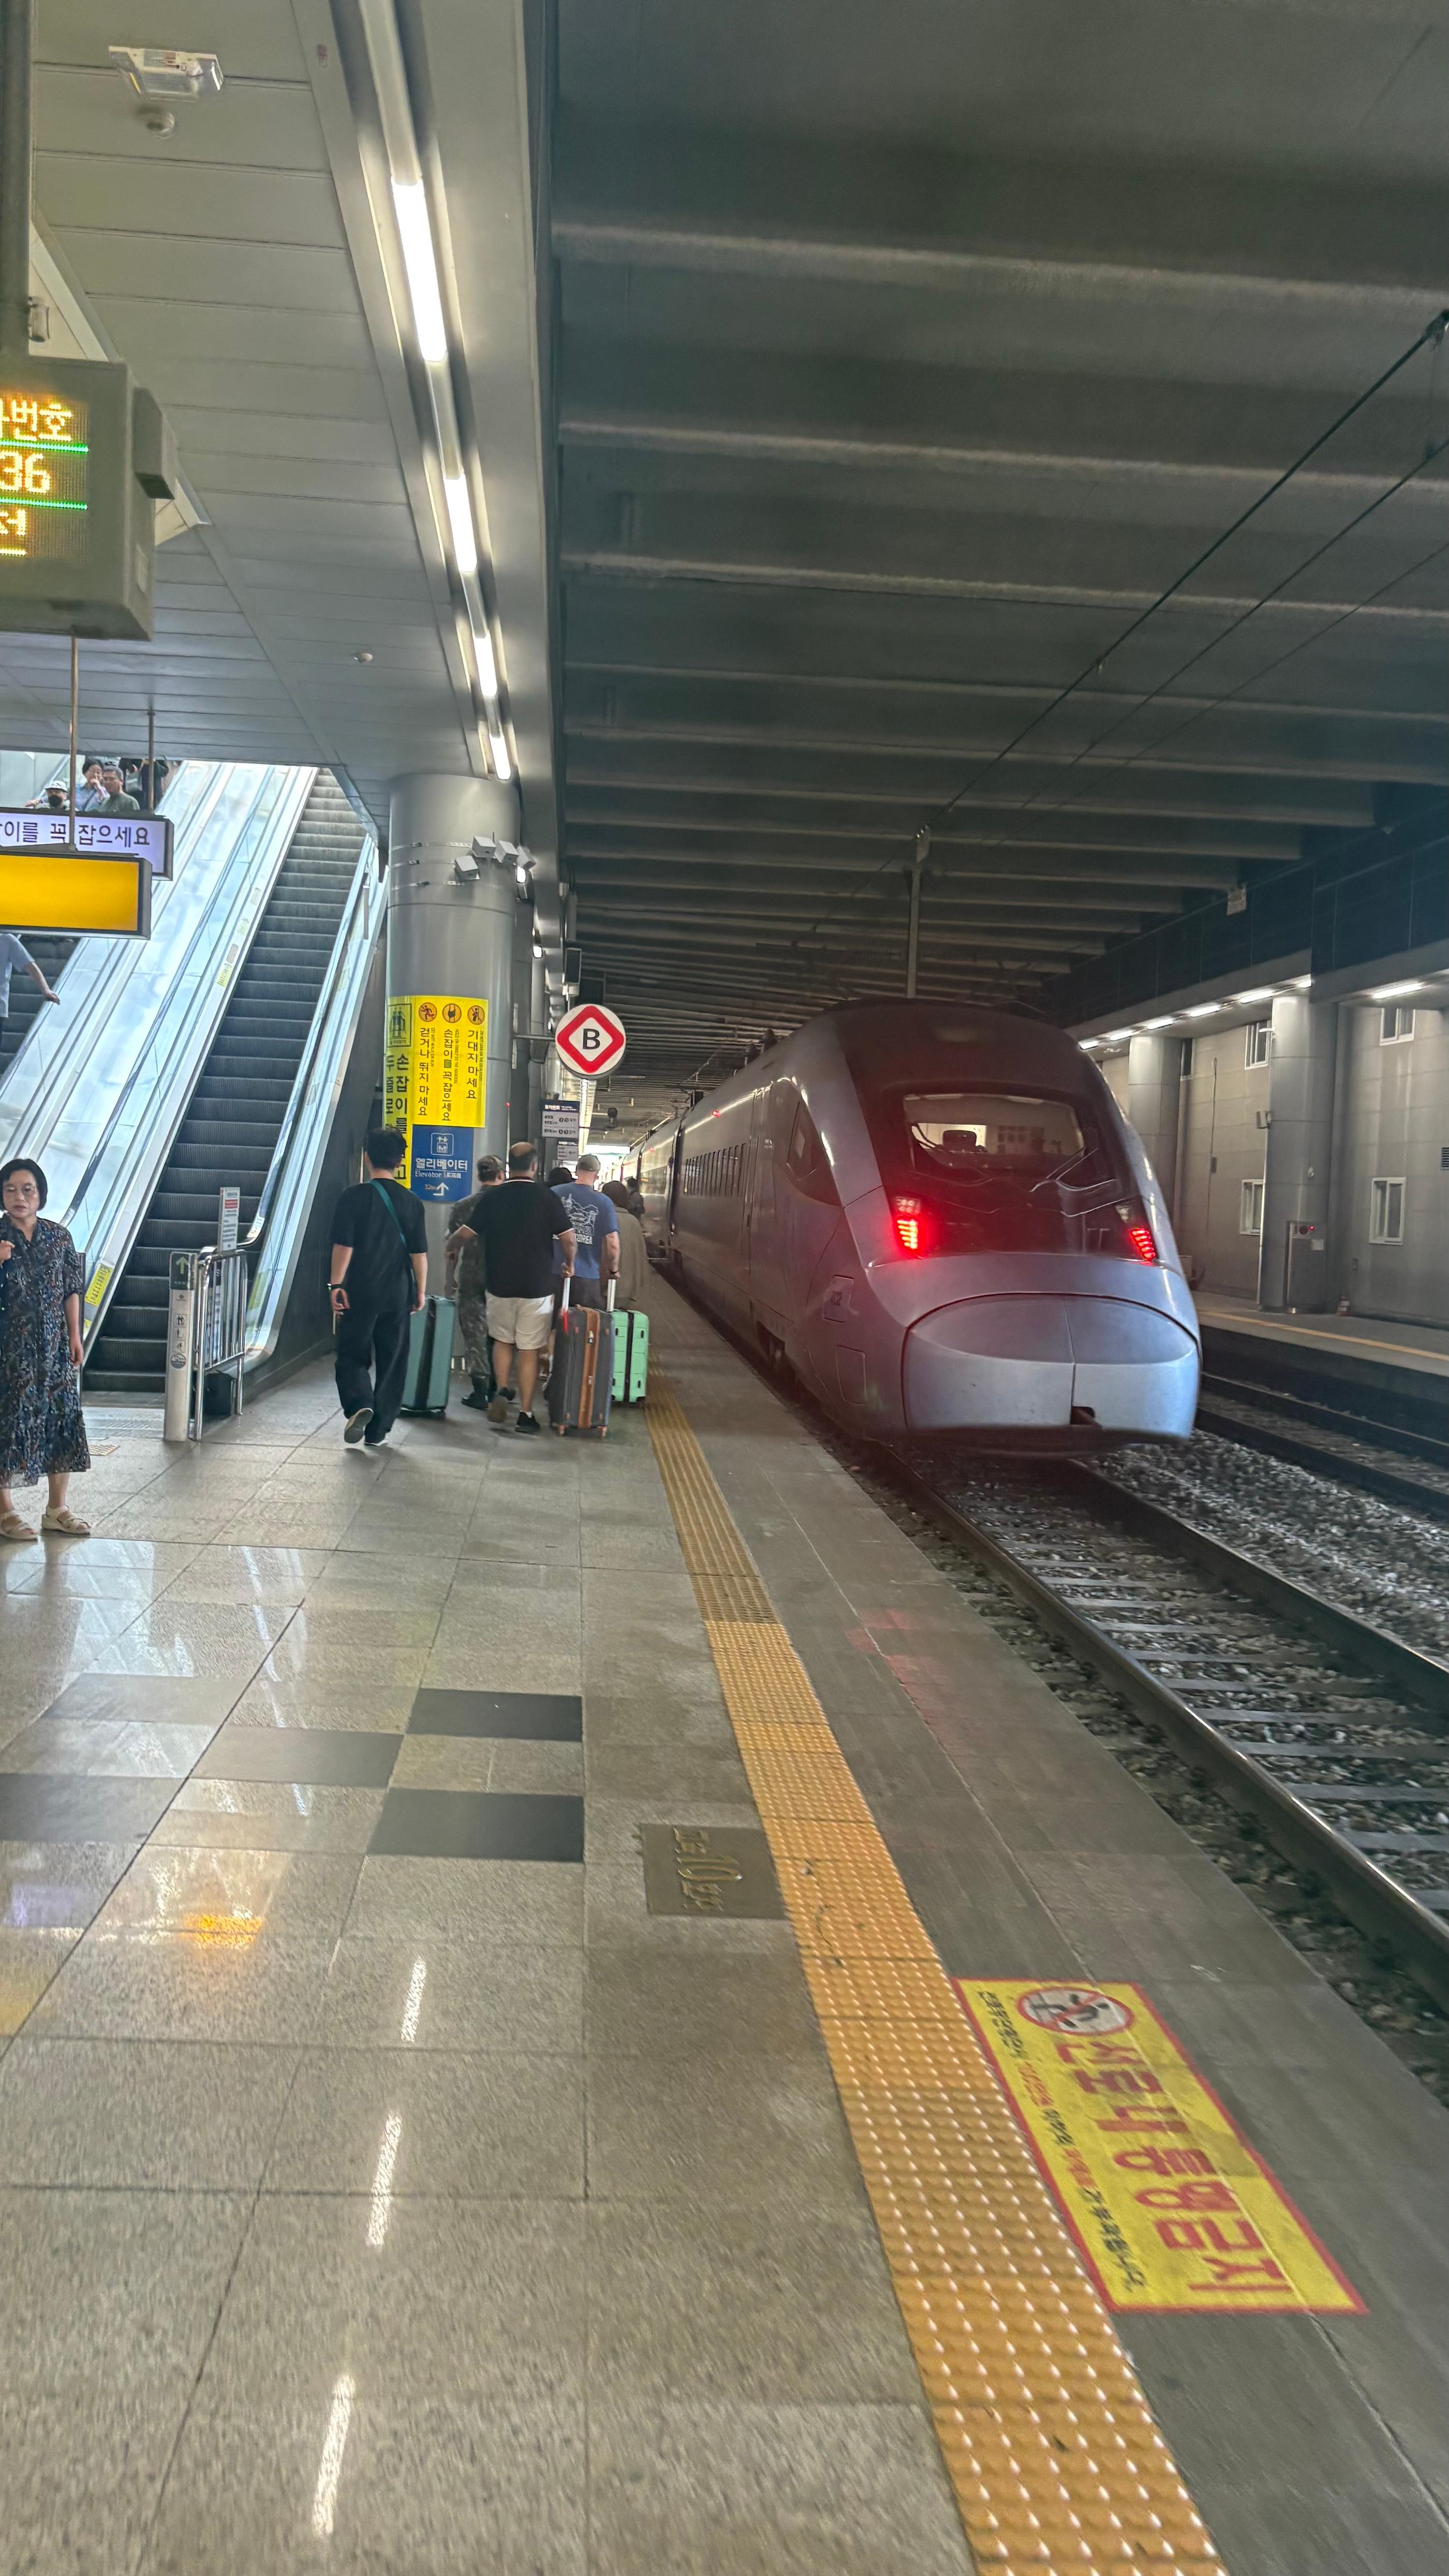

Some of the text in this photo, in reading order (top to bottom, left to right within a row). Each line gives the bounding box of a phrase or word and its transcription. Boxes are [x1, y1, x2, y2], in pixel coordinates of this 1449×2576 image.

[0, 821, 150, 848] 이를 꼭 잡으세요
[582, 1028, 600, 1050] B
[418, 1028, 431, 1116] 걷거나 뛰지 마세요
[441, 1029, 454, 1121] 손잡이를 꼭 잡으세요
[466, 1030, 479, 1099] 기대지 마세요
[415, 1169, 442, 1178] Elevator
[416, 1158, 468, 1171] 엘리베이터
[1055, 2041, 1163, 2094] 선로
[1111, 2144, 1293, 2295] 통행금지
